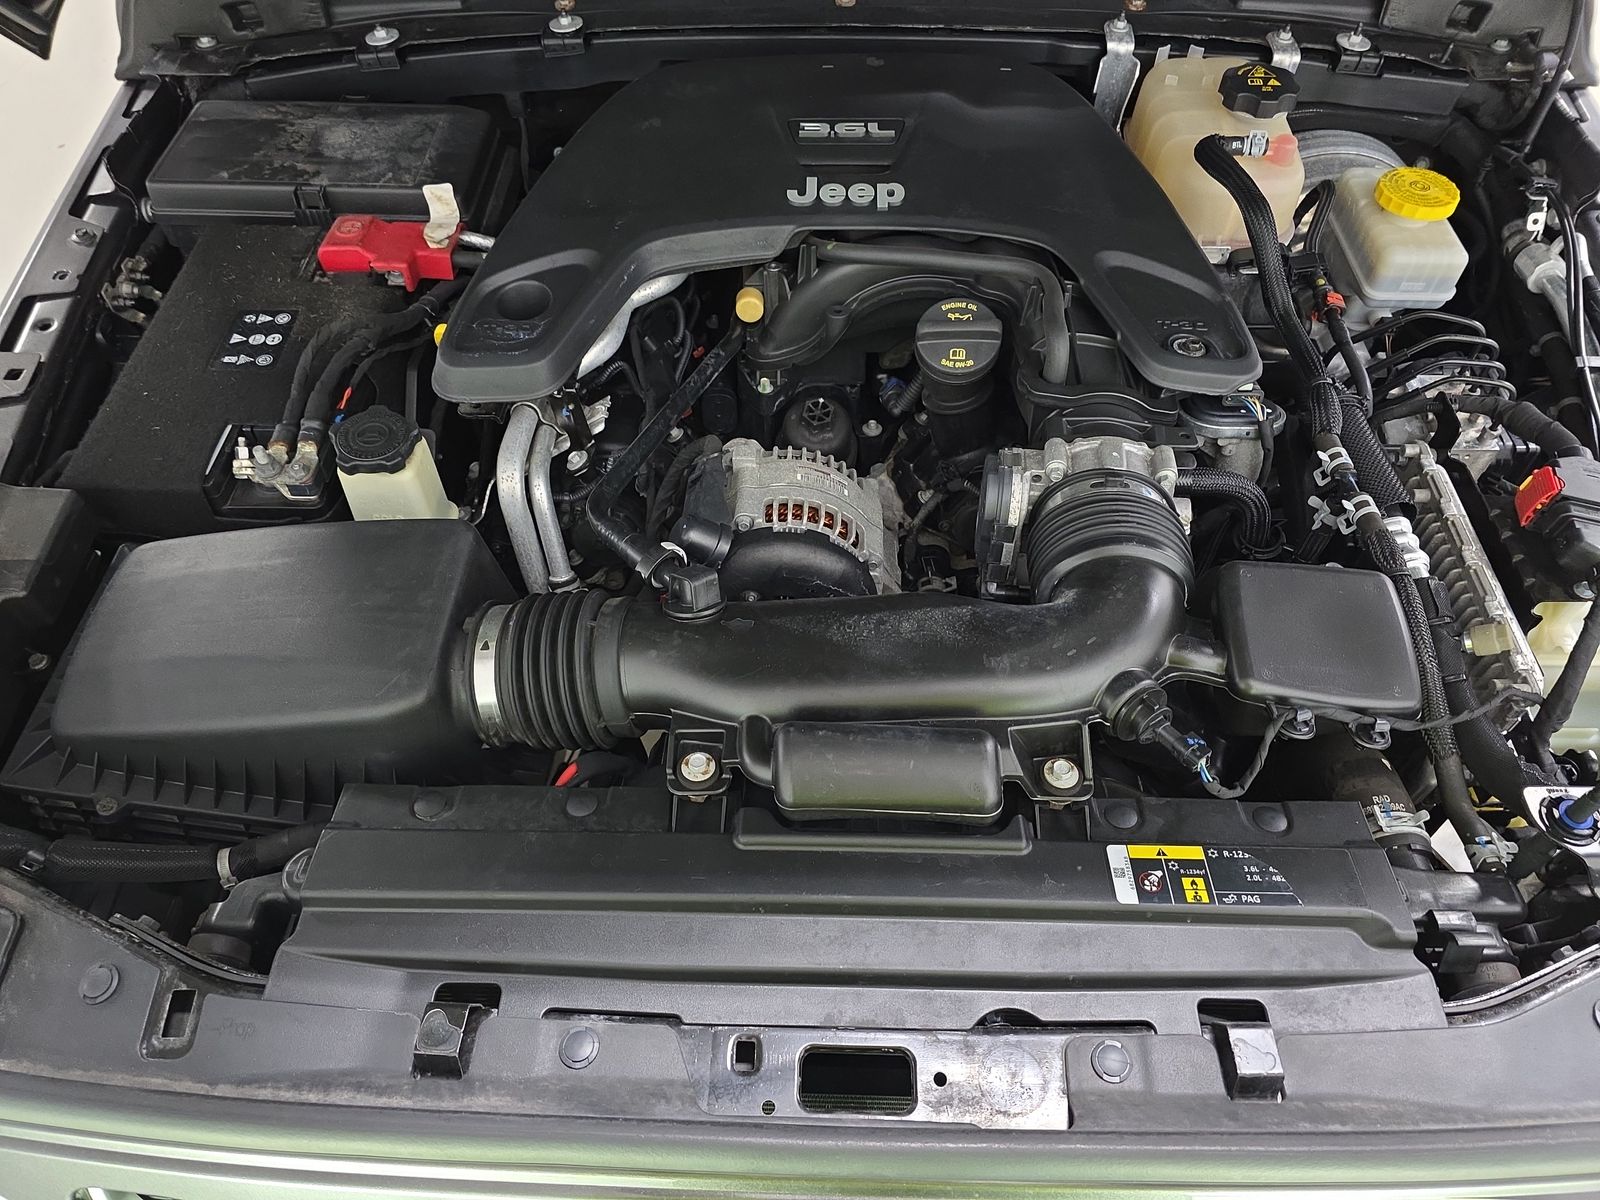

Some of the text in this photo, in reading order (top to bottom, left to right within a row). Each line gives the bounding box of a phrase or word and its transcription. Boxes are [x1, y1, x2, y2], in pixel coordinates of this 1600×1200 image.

[799, 122, 896, 138] 3.6L
[786, 176, 906, 211] Jeep
[941, 302, 978, 312] ENGINE OIL
[941, 358, 974, 369] SAE 0W-20
[1372, 794, 1391, 805] RAD
[1243, 865, 1260, 873] 3.6L
[1245, 874, 1263, 882] 2.0L
[1241, 894, 1261, 904] PAG
